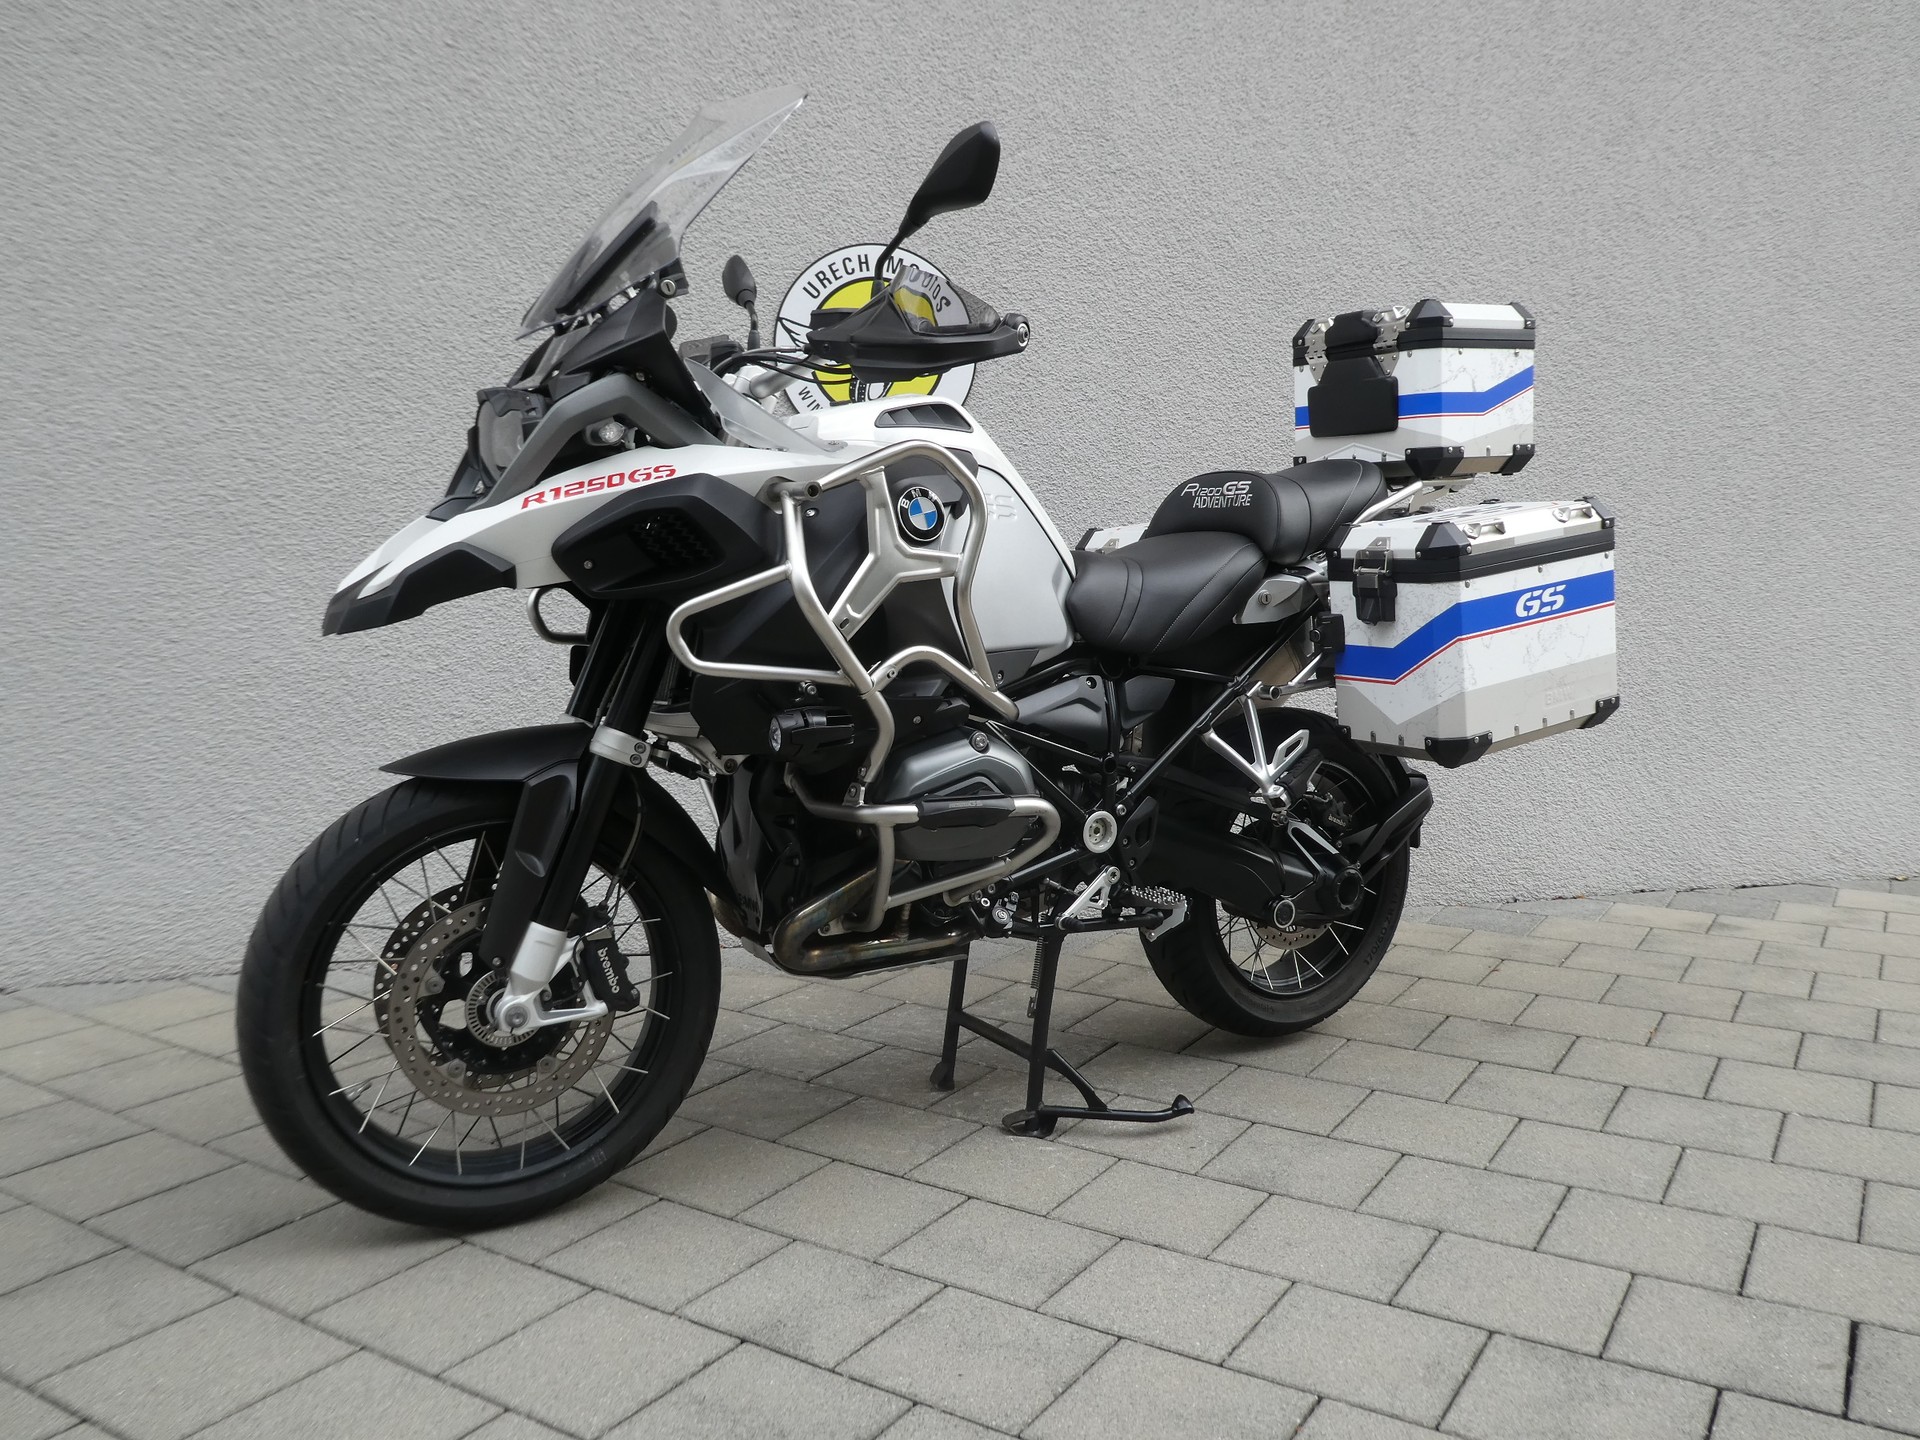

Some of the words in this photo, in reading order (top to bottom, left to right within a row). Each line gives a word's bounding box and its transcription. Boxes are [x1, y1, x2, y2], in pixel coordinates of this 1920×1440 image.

[802, 253, 871, 299] URECH
[521, 464, 677, 509] R1250GS
[900, 488, 939, 509] BMW
[1180, 480, 1252, 497] R1200GS
[1192, 493, 1253, 509] ADVENTURE
[1515, 584, 1567, 618] GS
[597, 946, 620, 994] brembo
